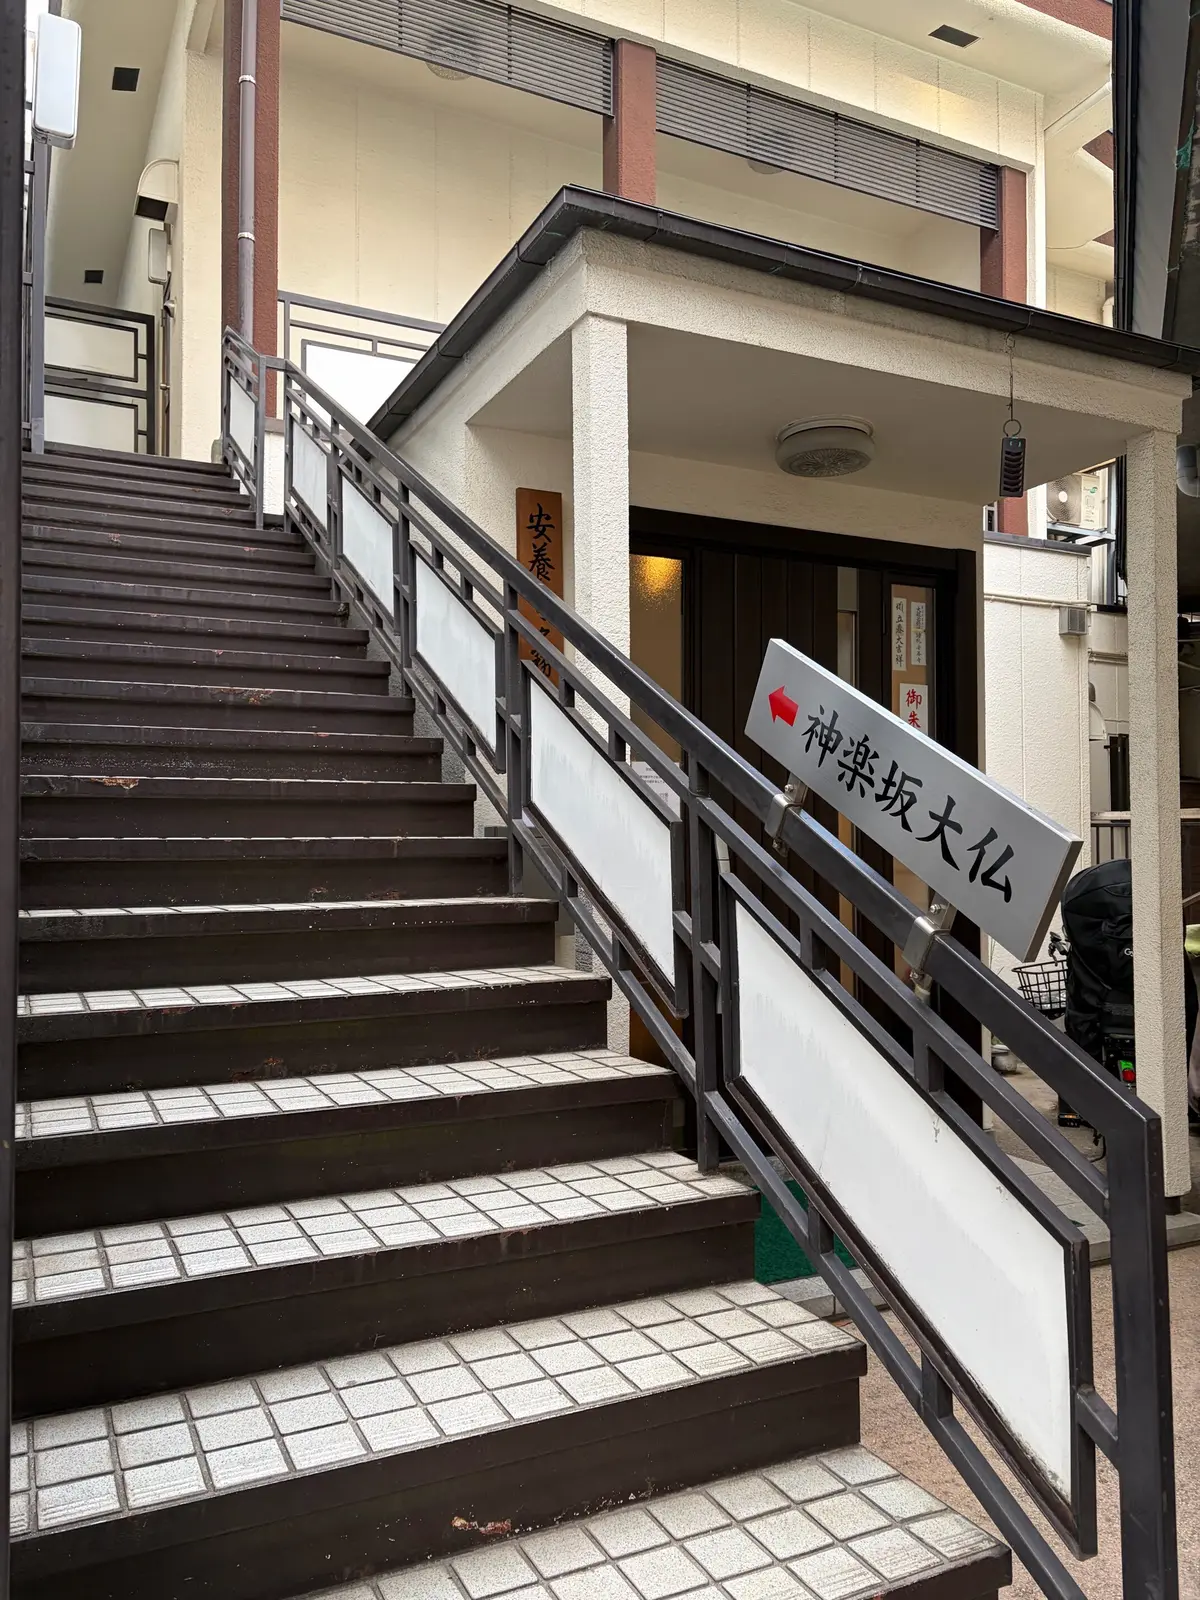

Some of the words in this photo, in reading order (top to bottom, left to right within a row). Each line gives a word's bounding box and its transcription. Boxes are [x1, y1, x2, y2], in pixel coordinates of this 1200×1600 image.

[801, 704, 1015, 904] 神楽坂大仏
